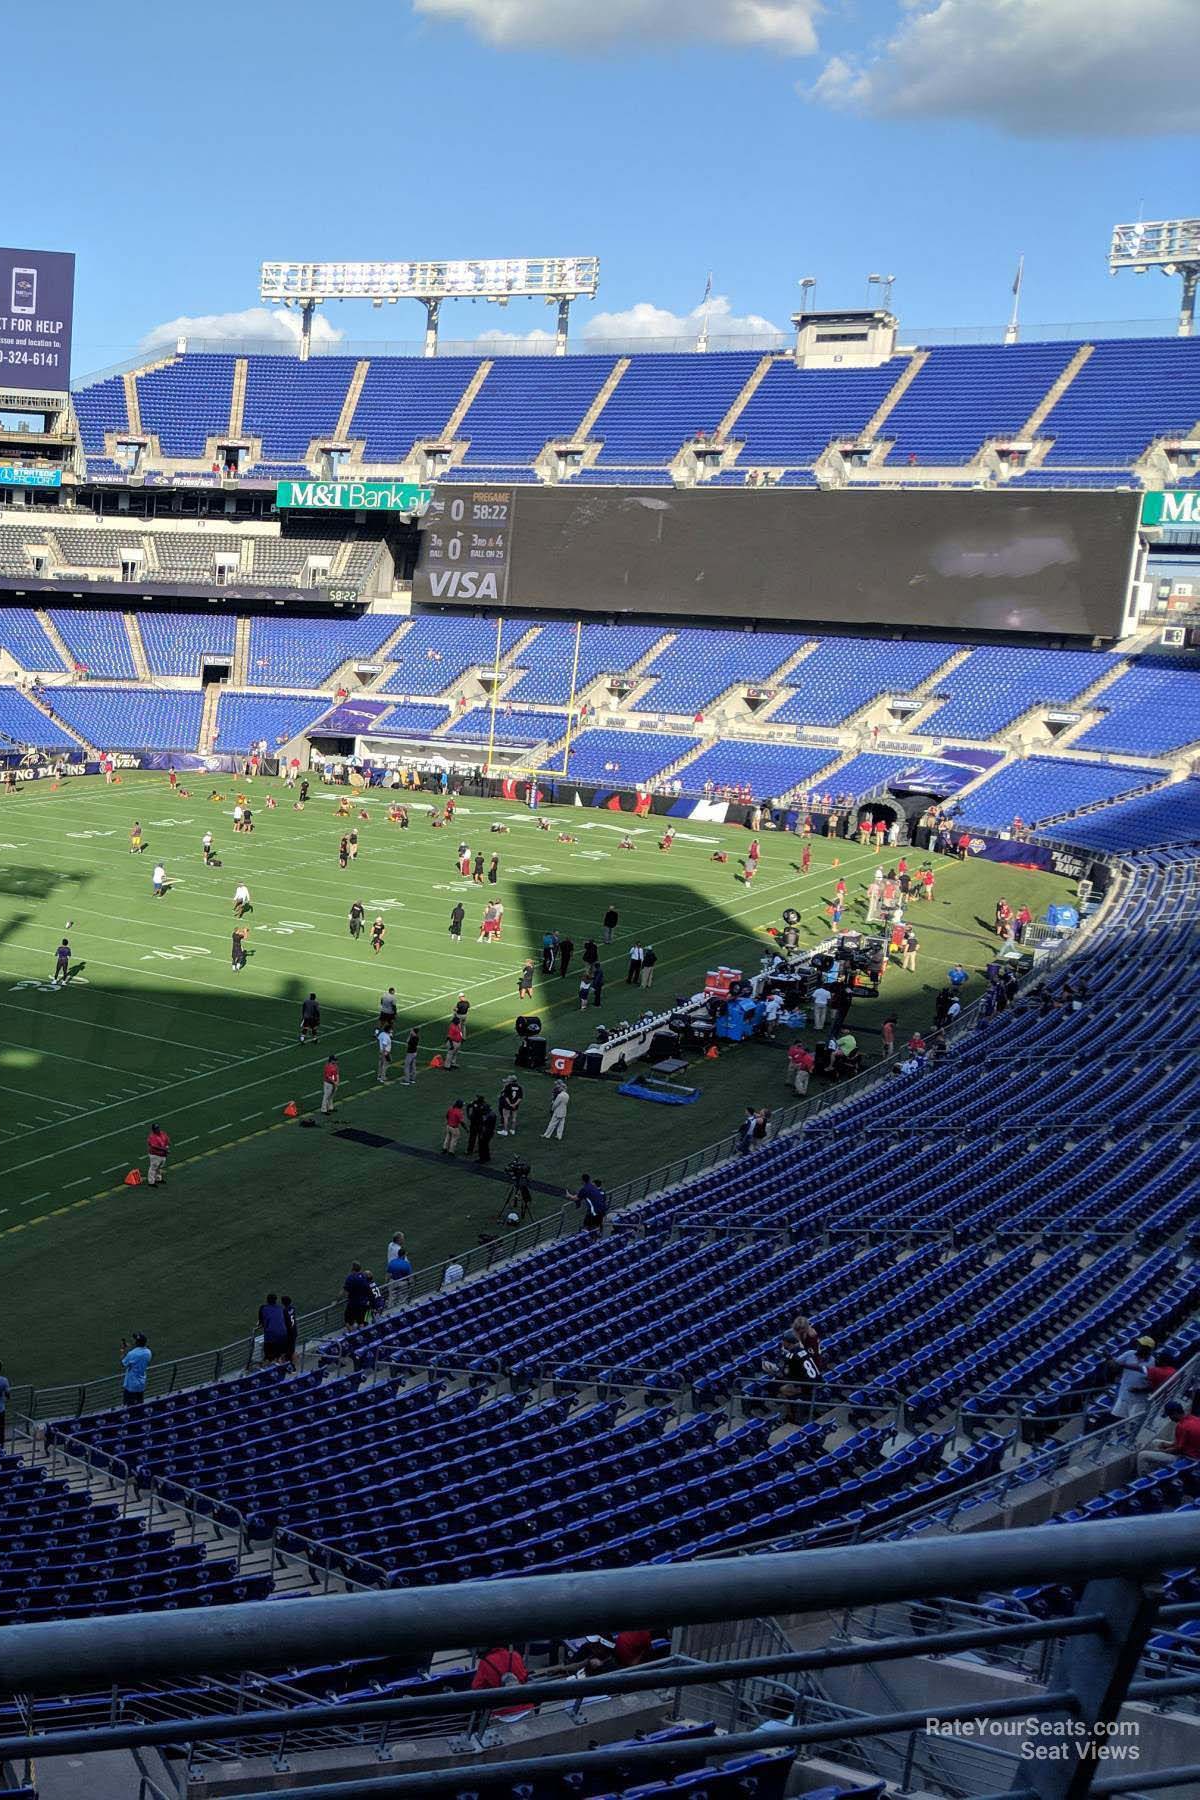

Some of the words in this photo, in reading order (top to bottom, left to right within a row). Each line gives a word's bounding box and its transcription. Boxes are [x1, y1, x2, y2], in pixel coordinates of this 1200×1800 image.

[11, 317, 32, 332] FOR
[36, 319, 63, 334] HELP
[15, 338, 27, 346] and
[28, 338, 52, 347] location
[290, 483, 347, 507] M&T
[351, 484, 404, 508] Bank
[472, 492, 510, 502] PREGAME
[451, 499, 465, 521] 0
[473, 505, 508, 520] 58:22
[448, 538, 461, 560] 0
[495, 535, 503, 547] 4
[429, 571, 498, 599] VISA
[329, 590, 357, 601] 58:22
